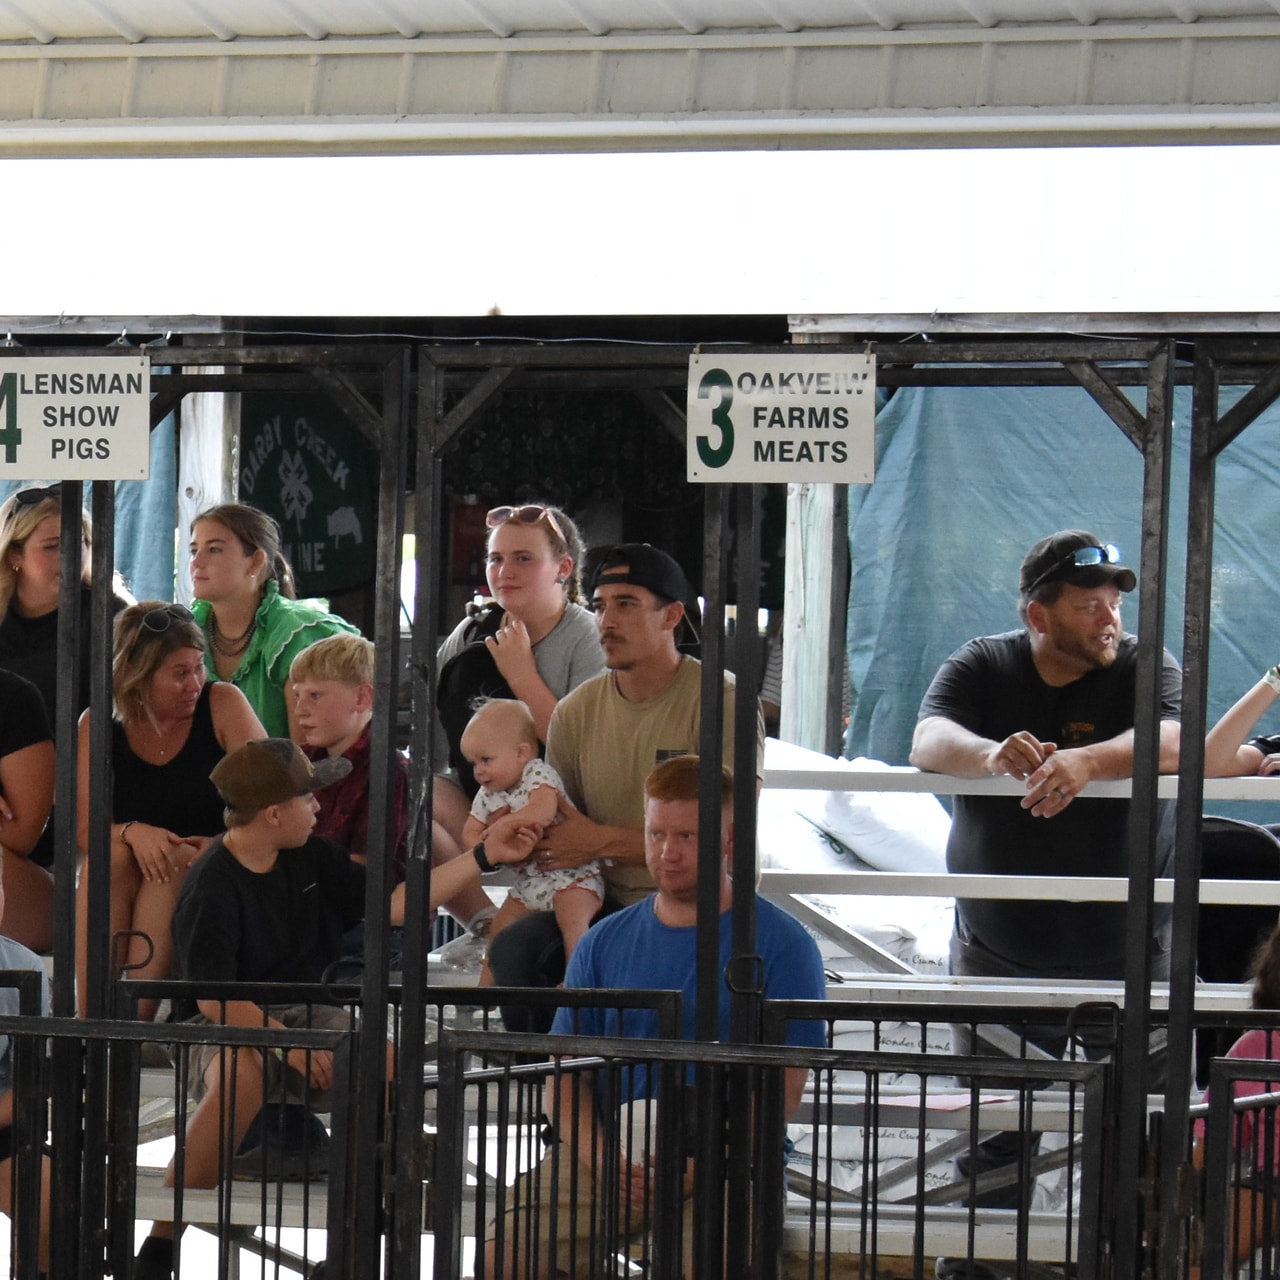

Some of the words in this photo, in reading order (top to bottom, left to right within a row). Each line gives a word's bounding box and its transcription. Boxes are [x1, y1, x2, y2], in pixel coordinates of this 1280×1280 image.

[20, 373, 143, 394] LENSMAN
[42, 405, 120, 427] SHOW
[696, 368, 735, 468] 3
[753, 406, 849, 429] FARMS
[51, 438, 110, 459] PIGS
[241, 416, 282, 495] DARBY
[295, 417, 350, 490] CREEK
[753, 440, 848, 463] MEATS
